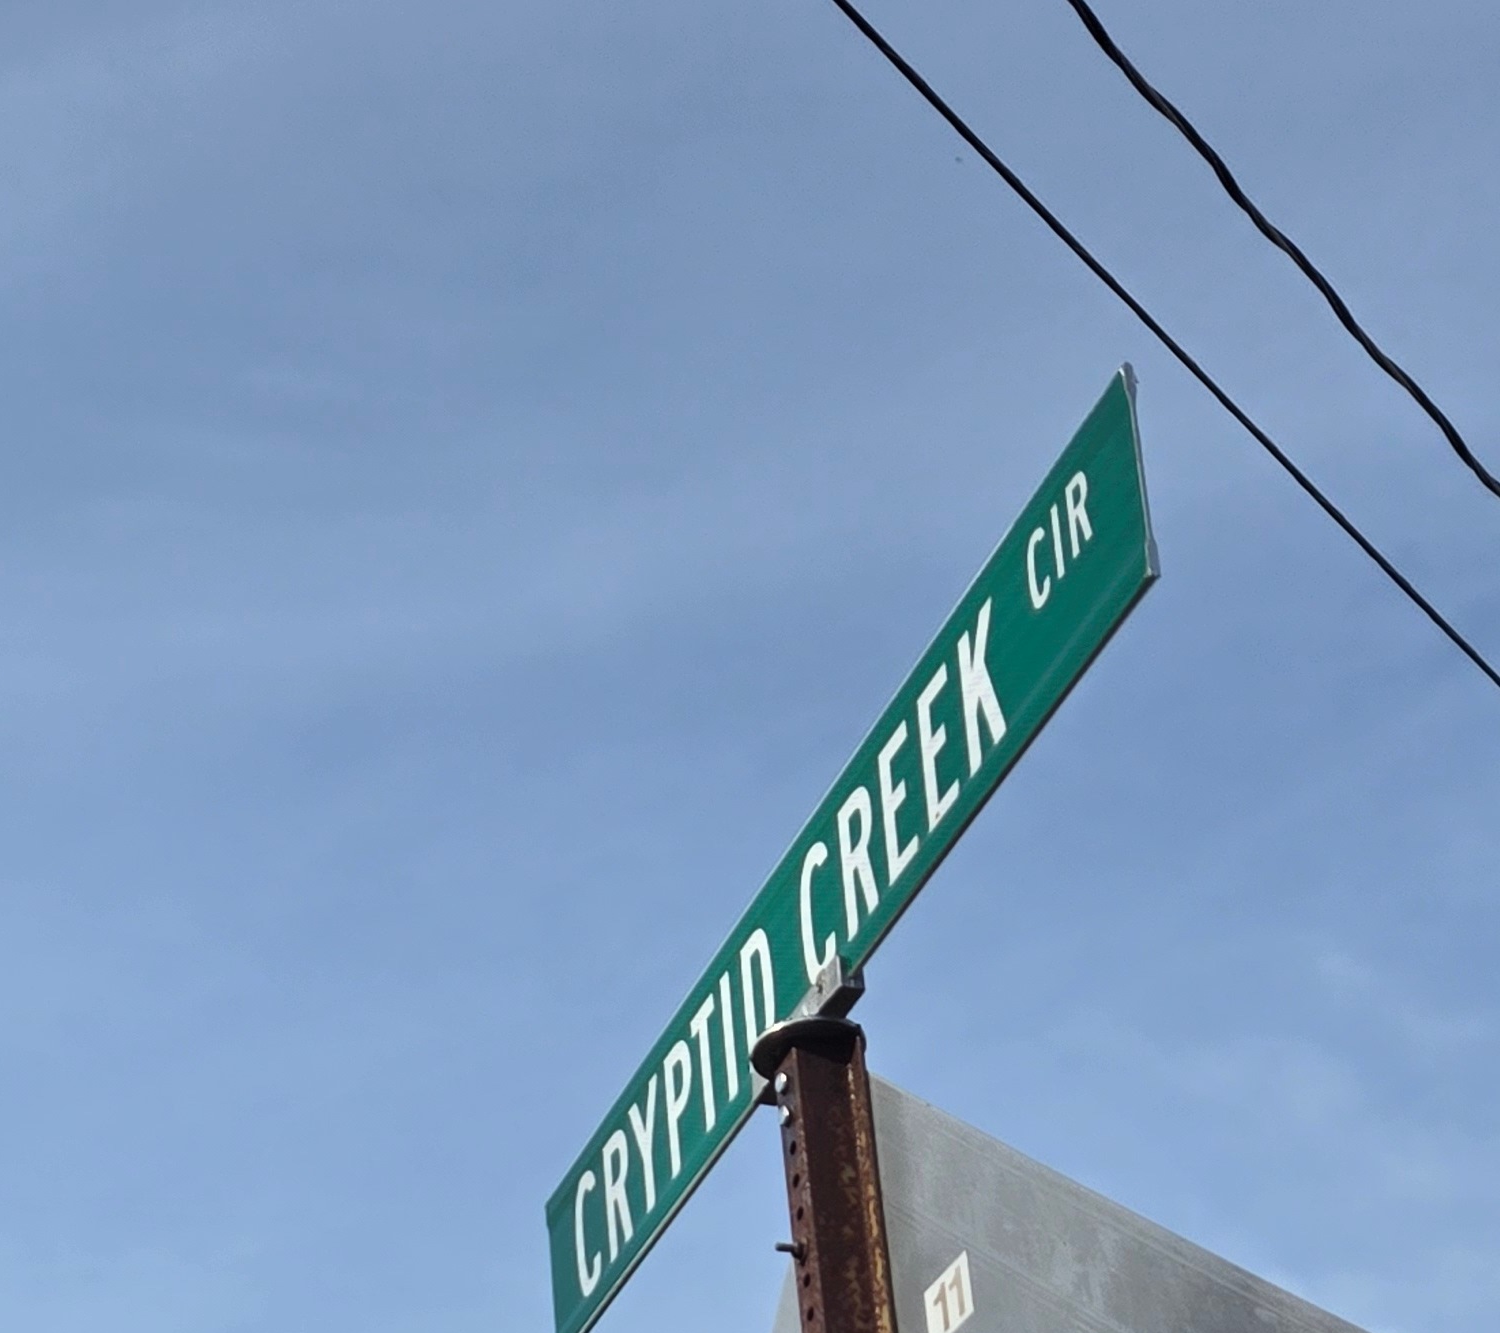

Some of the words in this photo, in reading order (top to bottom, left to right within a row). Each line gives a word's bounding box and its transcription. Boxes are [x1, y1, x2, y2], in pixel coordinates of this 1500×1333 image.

[575, 928, 775, 1298] CRYPTID
[800, 598, 1007, 986] CREEK
[1026, 470, 1093, 610] CIR
[933, 1263, 966, 1333] 11
